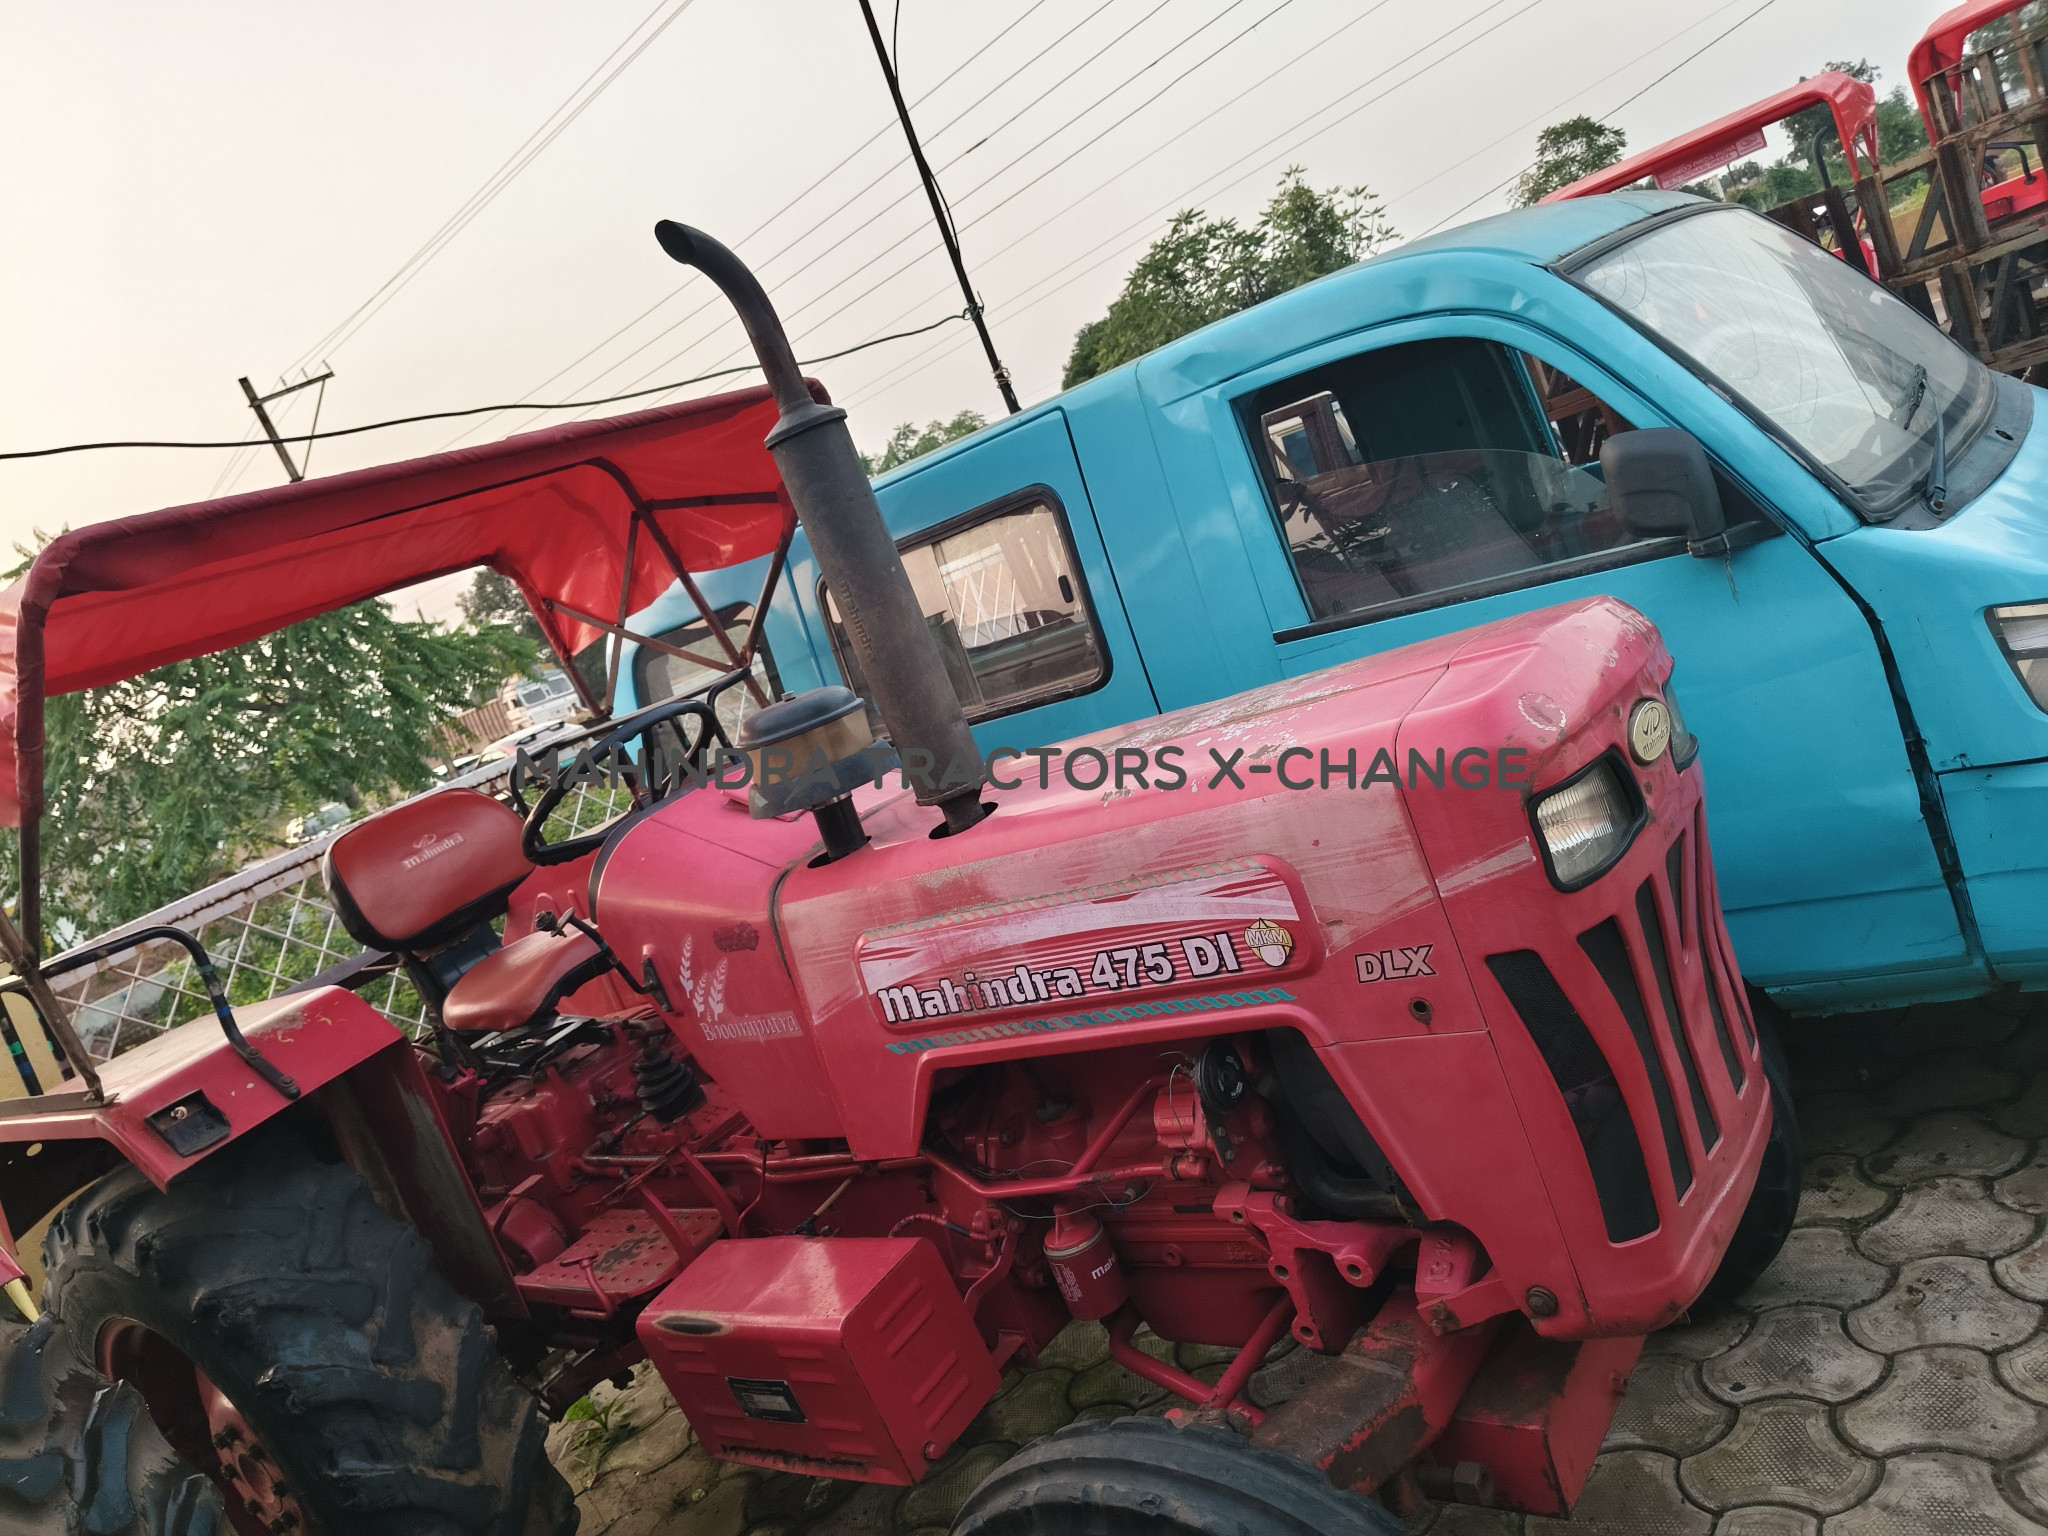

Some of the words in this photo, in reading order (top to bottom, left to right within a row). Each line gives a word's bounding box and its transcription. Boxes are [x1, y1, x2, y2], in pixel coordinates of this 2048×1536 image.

[1246, 928, 1290, 947] MKM
[877, 965, 1085, 1024] Mahindra
[1090, 942, 1176, 990] 475
[1179, 931, 1244, 979] DI
[1354, 943, 1438, 984] DLX
